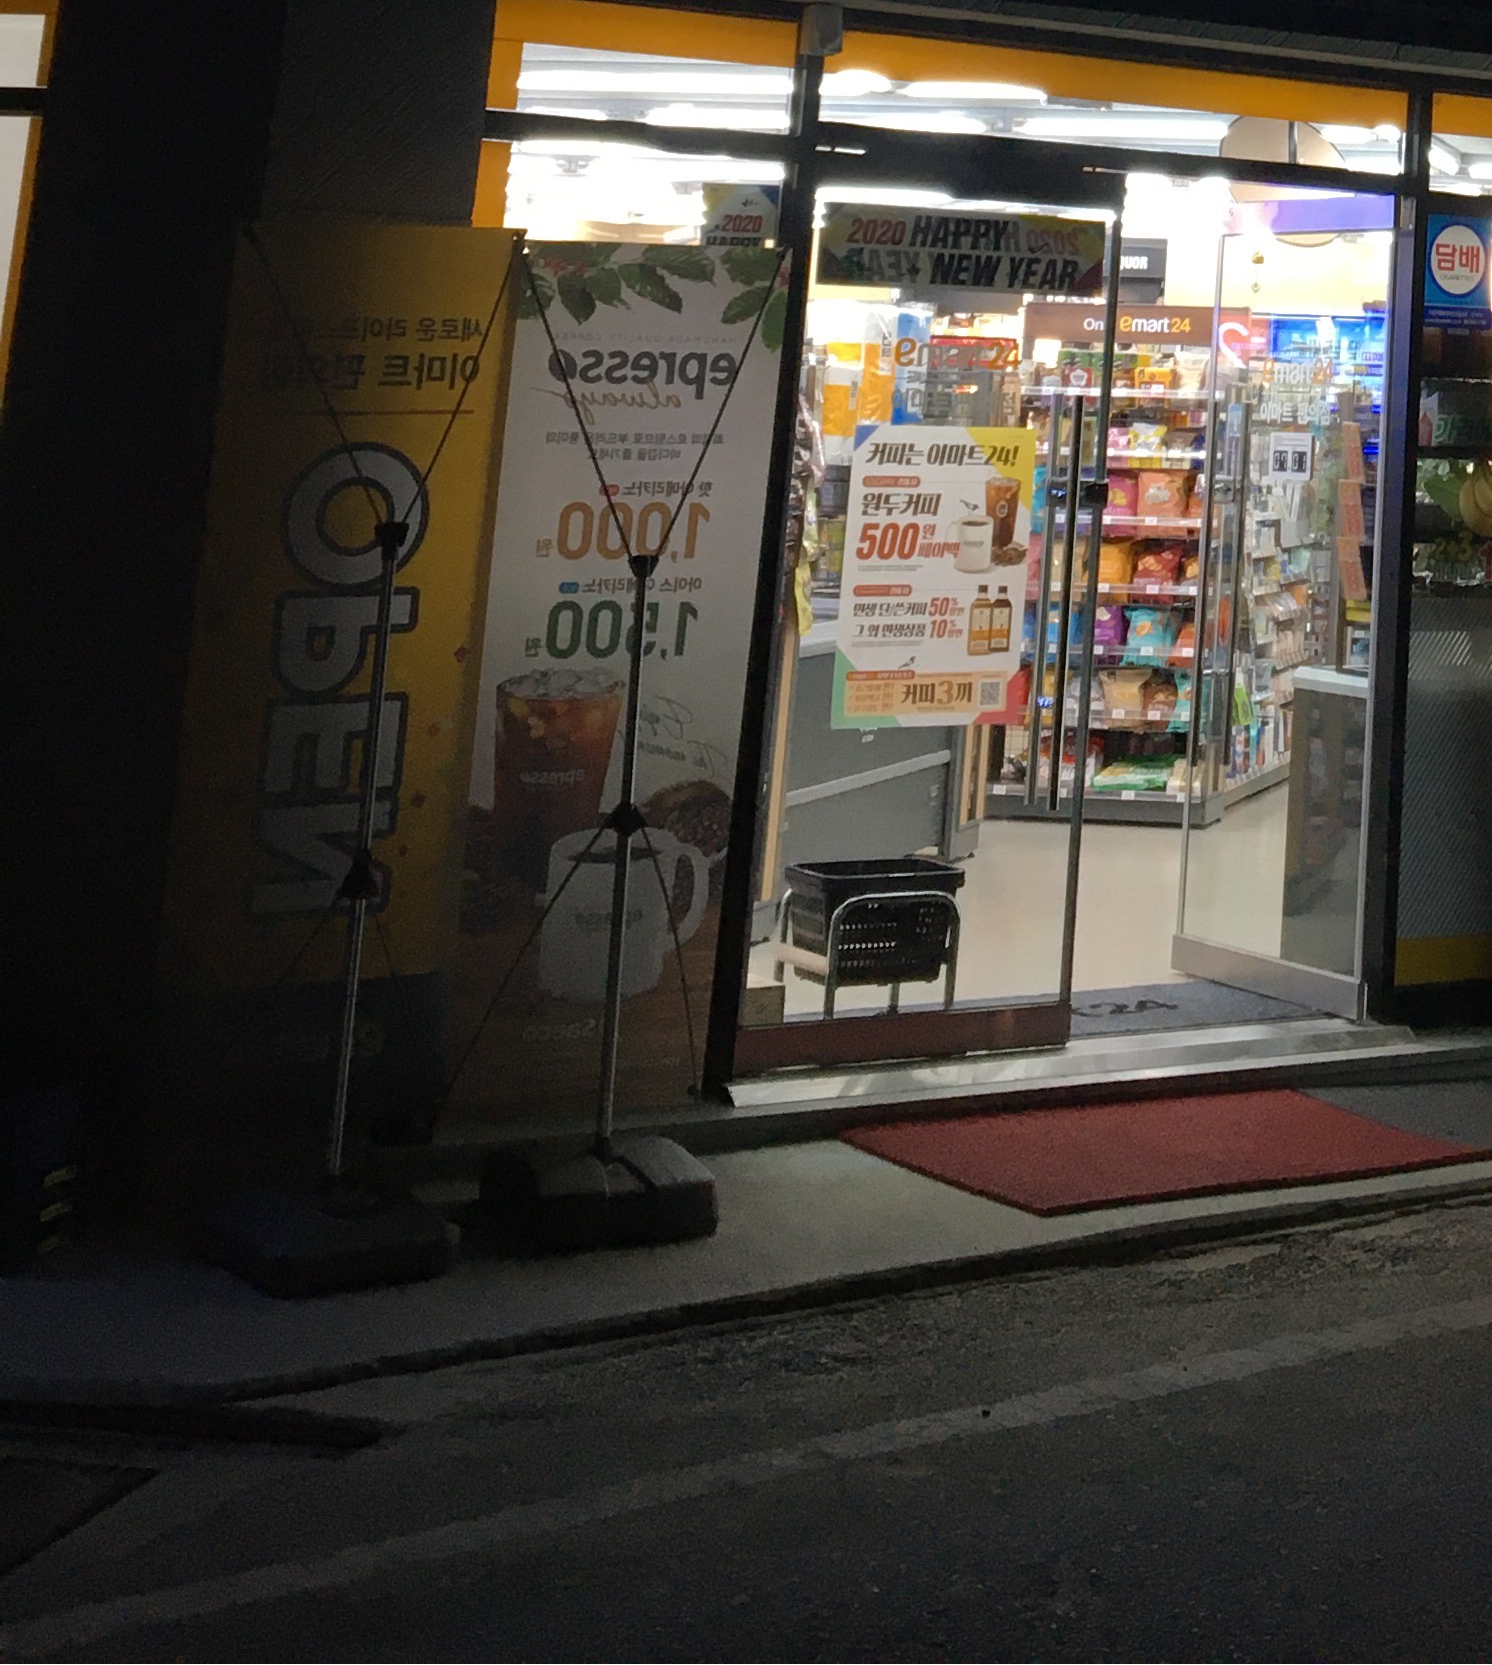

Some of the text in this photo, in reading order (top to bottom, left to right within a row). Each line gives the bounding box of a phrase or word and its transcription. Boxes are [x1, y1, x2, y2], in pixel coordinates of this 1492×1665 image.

[722, 214, 763, 233] 2020
[847, 215, 1010, 251] 2020 HAPPY
[930, 252, 1080, 291] NEW YEAR
[1436, 243, 1480, 273] 담배
[1119, 315, 1192, 333] emart24
[865, 442, 1019, 467] 커피는 이마트24!
[861, 492, 942, 516] 원두커피
[856, 522, 937, 560] 500 원
